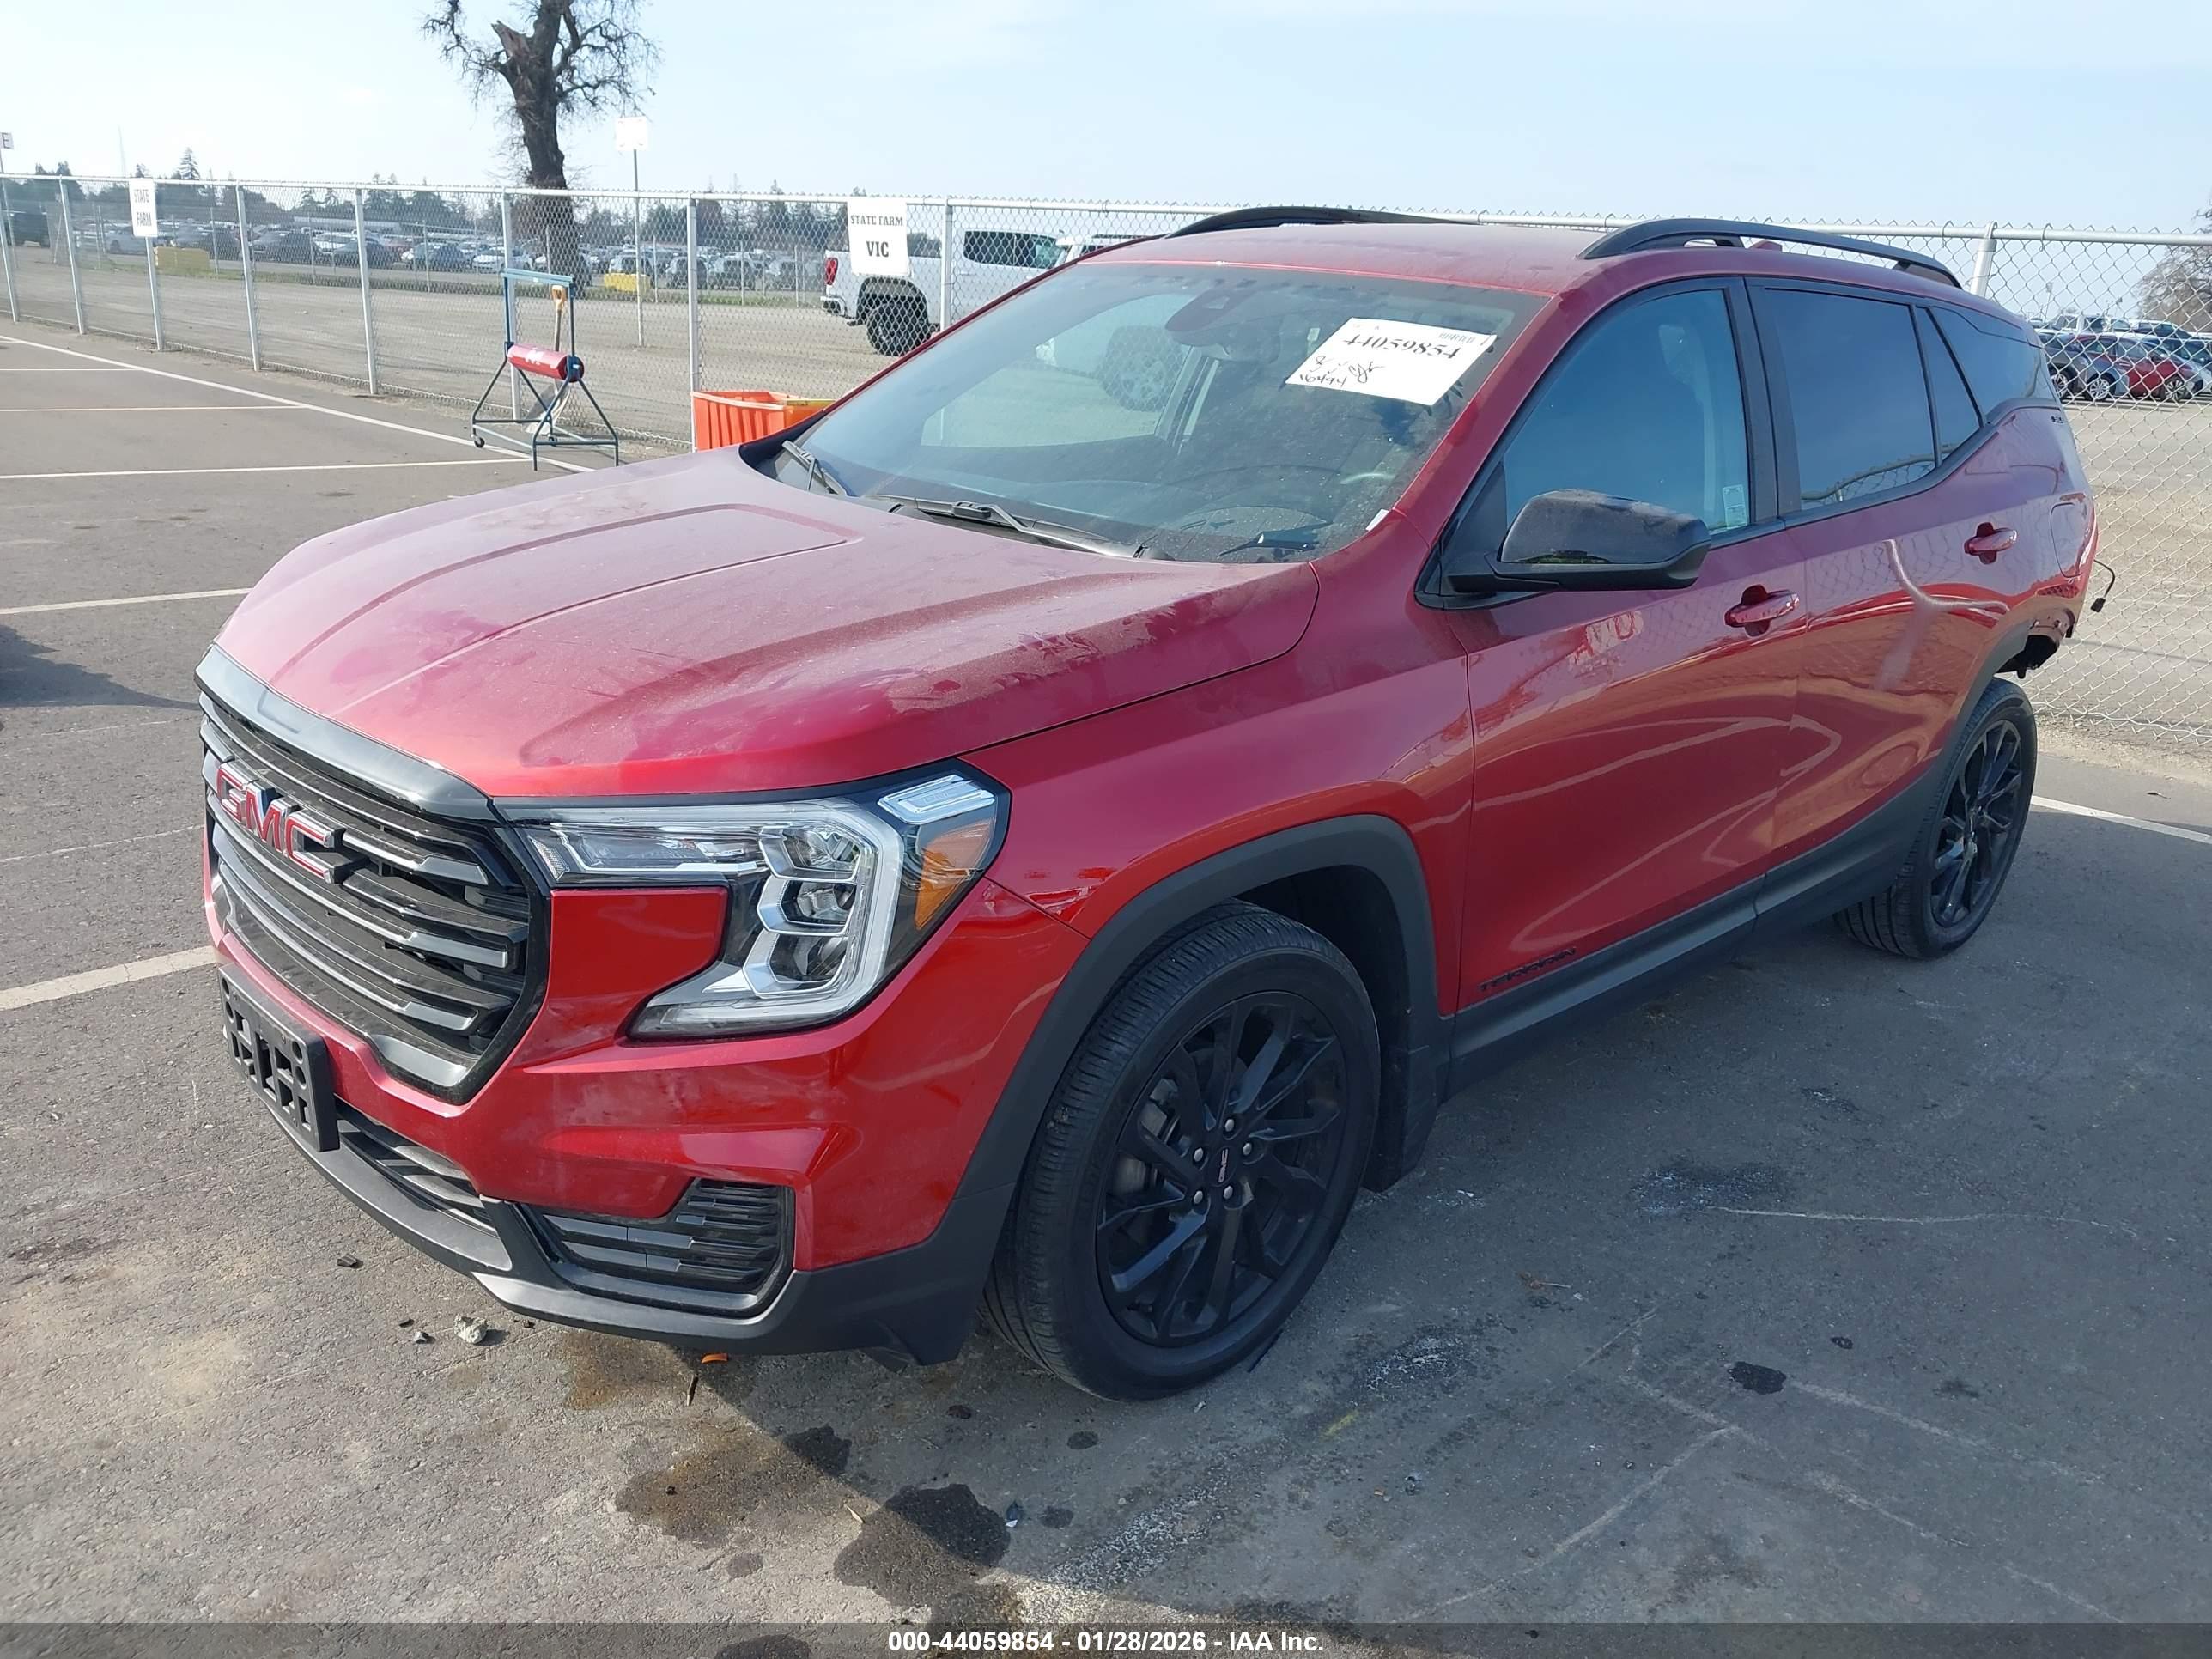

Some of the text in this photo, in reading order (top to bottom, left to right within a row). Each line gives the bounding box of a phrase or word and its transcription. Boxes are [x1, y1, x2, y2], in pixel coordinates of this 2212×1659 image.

[850, 214, 903, 227] STATE FARM
[866, 240, 890, 258] VIC
[1343, 333, 1462, 359] 44059854
[216, 762, 346, 884] GMC
